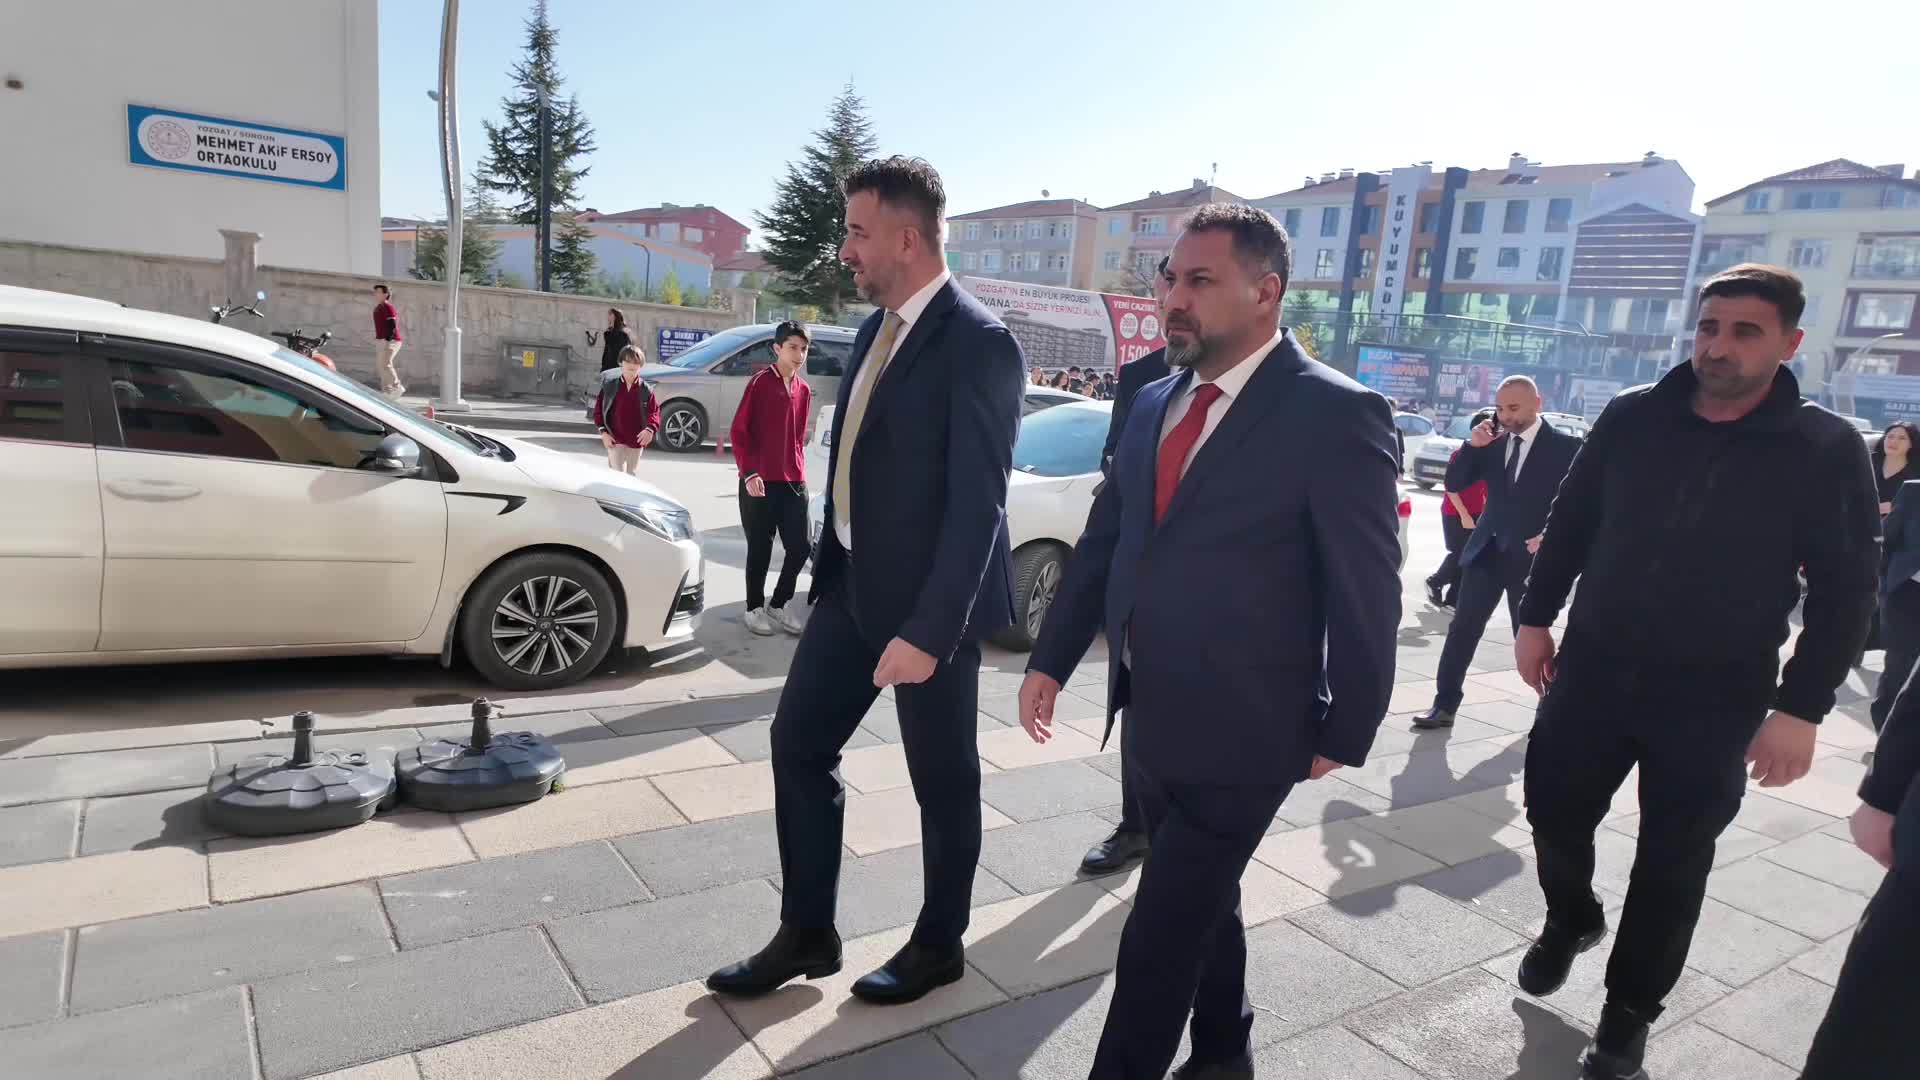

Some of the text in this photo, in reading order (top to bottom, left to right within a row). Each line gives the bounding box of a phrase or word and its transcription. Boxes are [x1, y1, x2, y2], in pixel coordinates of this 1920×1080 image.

[196, 134, 255, 153] MEHMET
[291, 148, 332, 163] ERSOY
[197, 150, 277, 171] ORTAOKULU
[1020, 288, 1031, 297] EN
